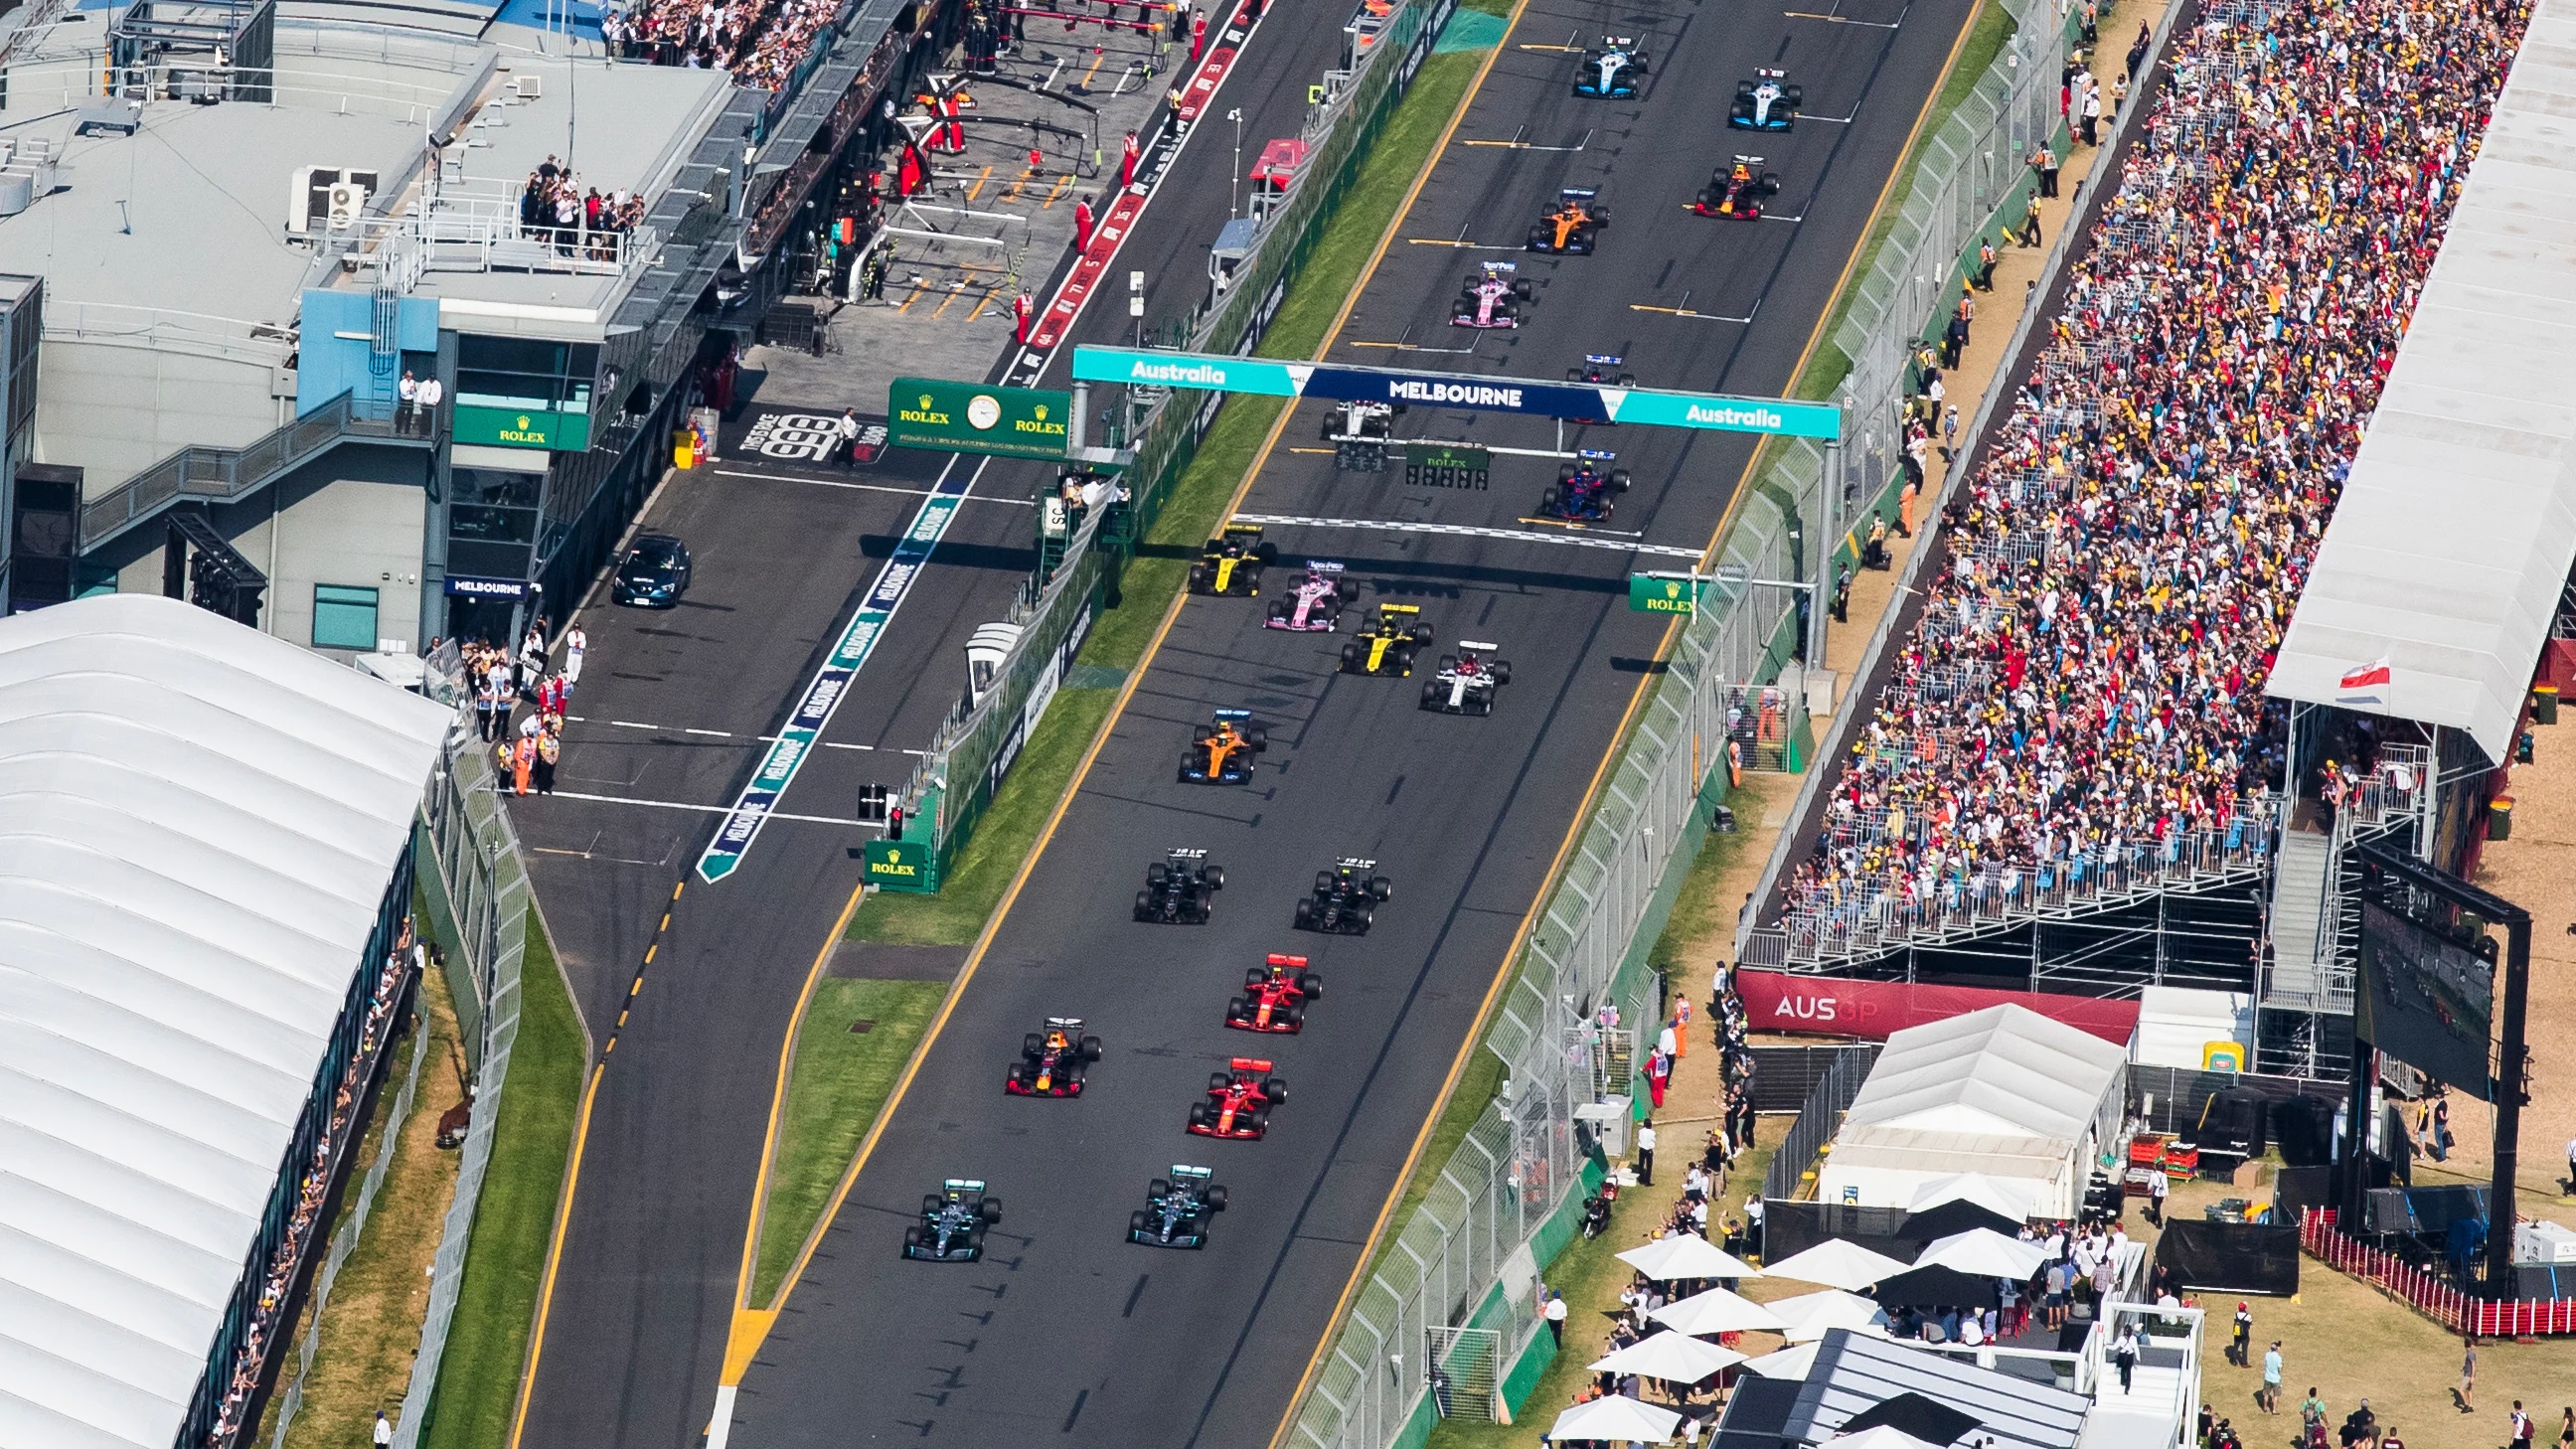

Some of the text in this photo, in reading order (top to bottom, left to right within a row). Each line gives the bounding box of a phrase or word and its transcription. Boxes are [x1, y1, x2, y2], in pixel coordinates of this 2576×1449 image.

[1131, 361, 1225, 385] Australia
[1389, 380, 1522, 407] MELBOURNE
[899, 409, 950, 424] ROLEX
[1687, 404, 1781, 427] Australia
[1015, 419, 1065, 434] ROLEX
[499, 429, 546, 443] ROLEX
[1427, 457, 1466, 469] ROLEX
[1051, 507, 1065, 525] SC
[454, 580, 522, 595] MELBOURNE
[876, 563, 914, 600] MELBOURNE
[840, 620, 880, 659] MELBOURNE
[802, 678, 843, 718] MELBOURNE
[872, 862, 915, 877] ROLEX
